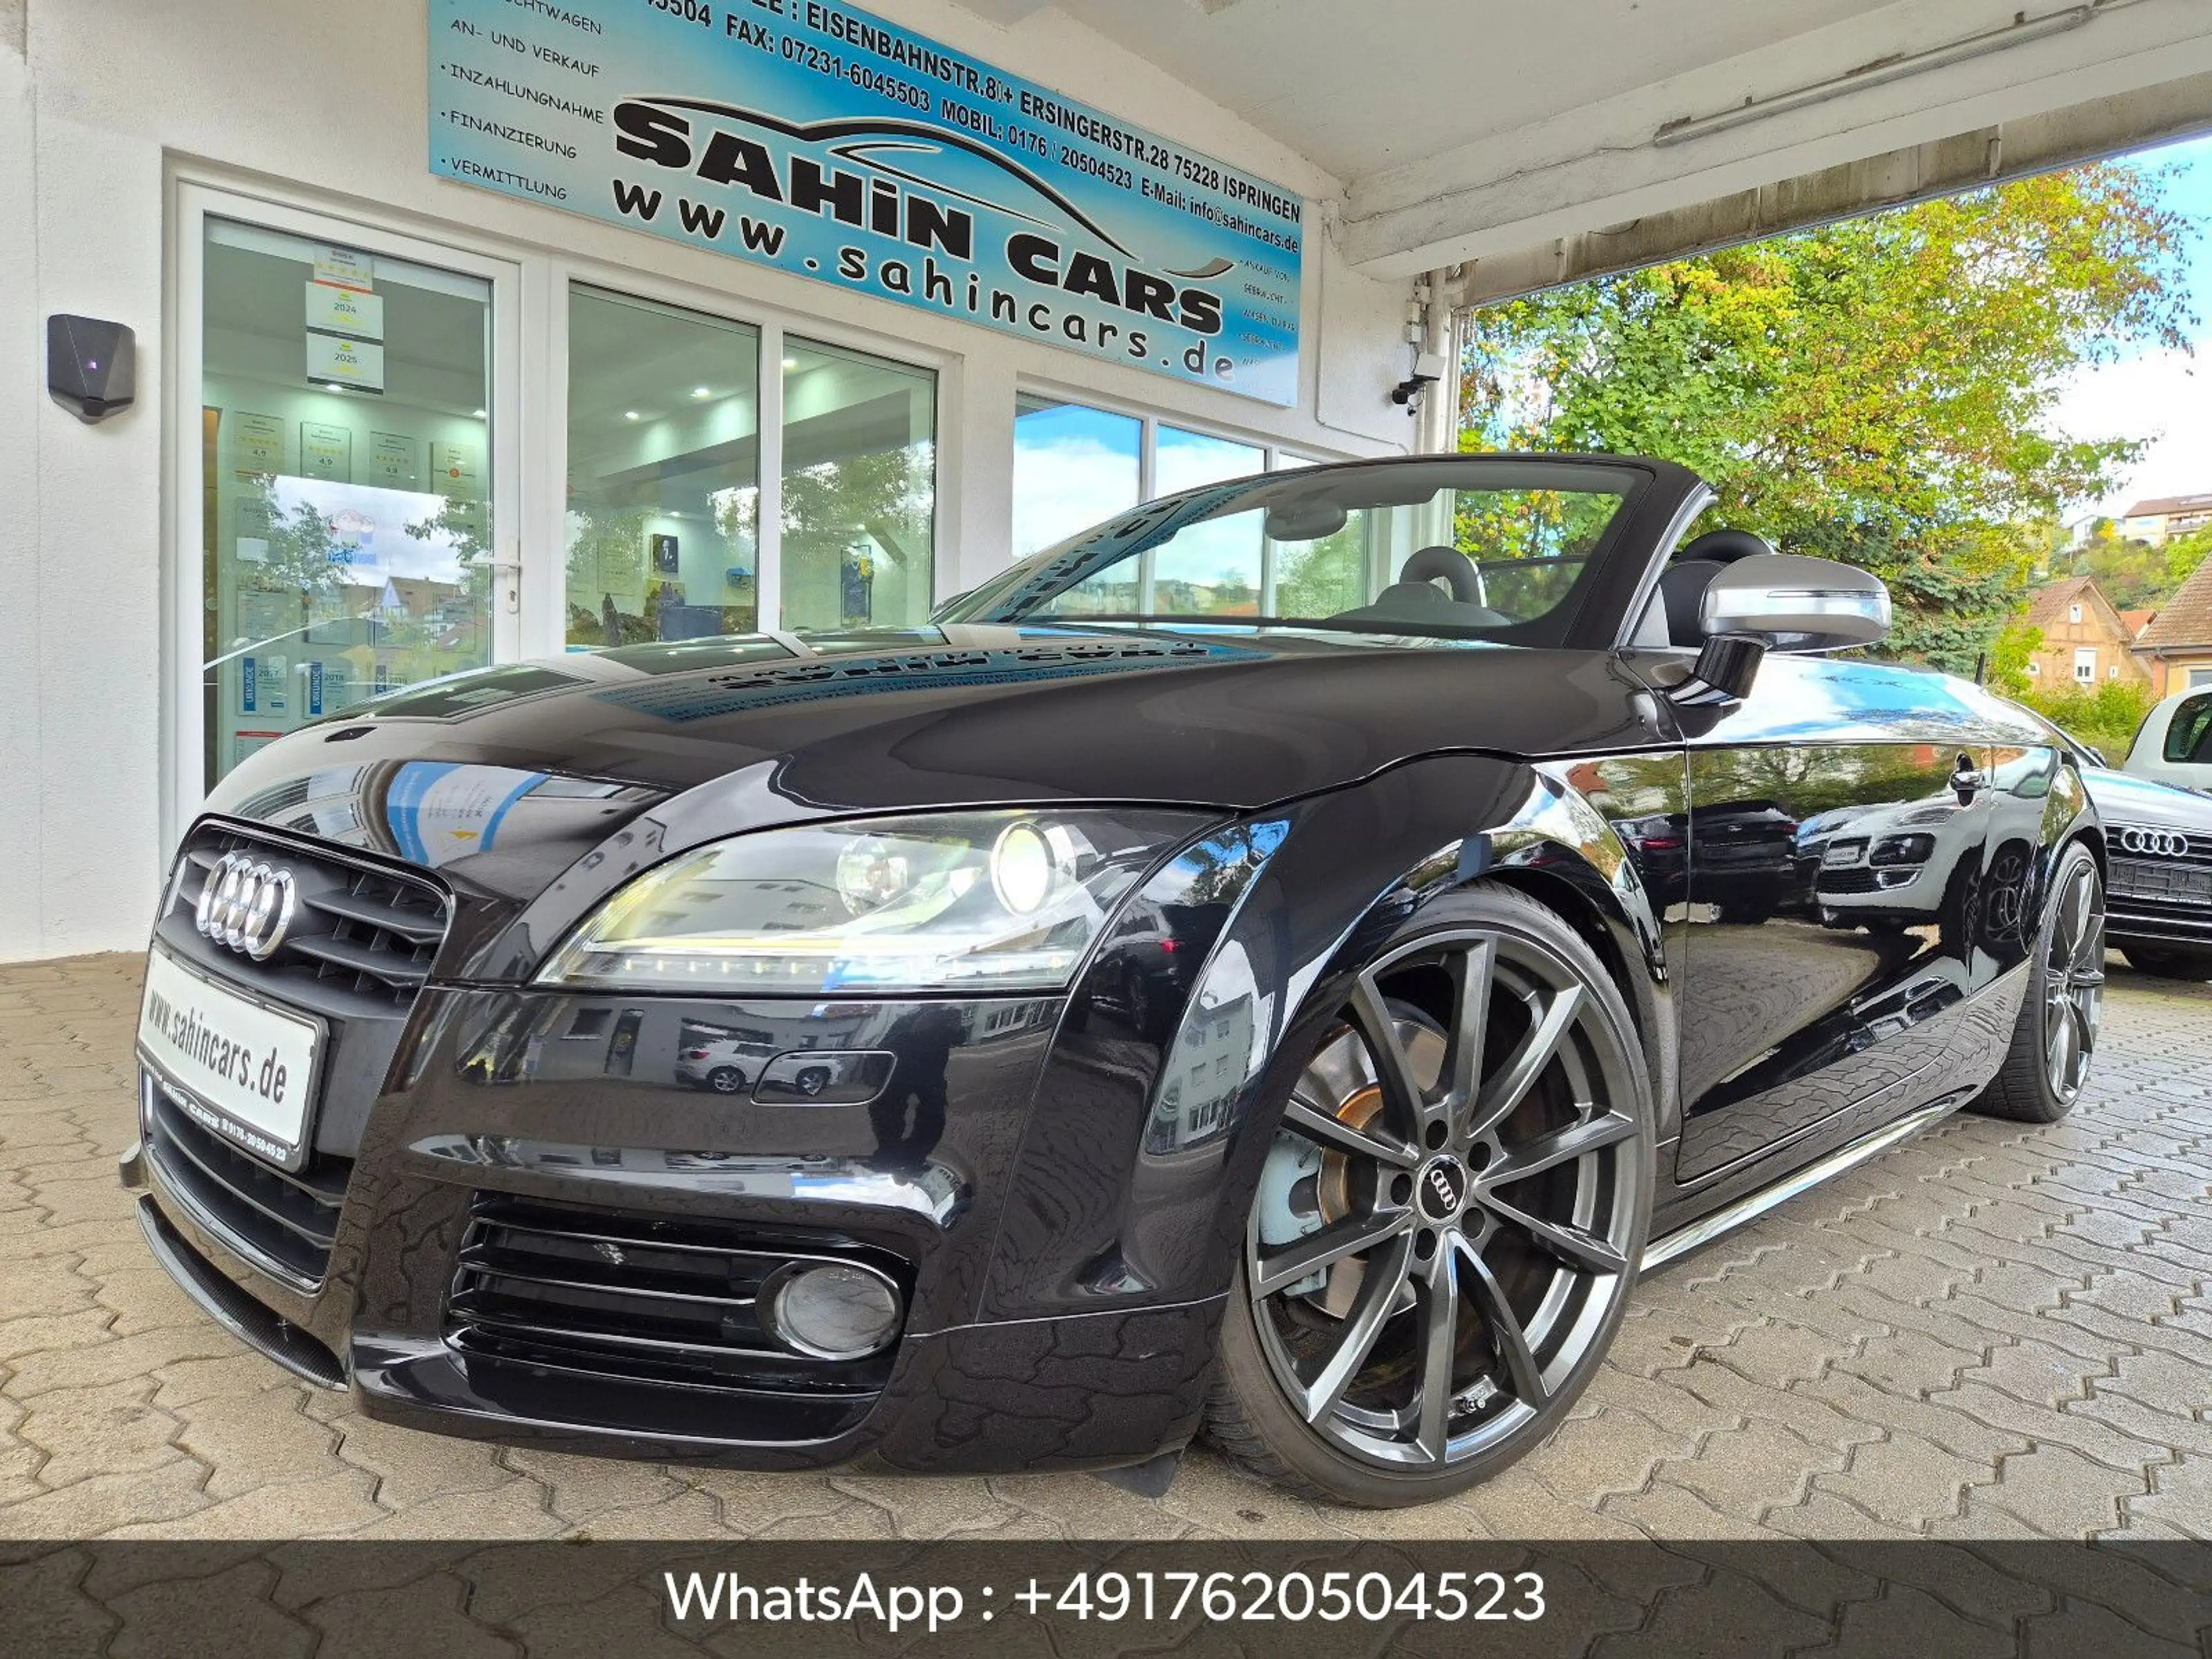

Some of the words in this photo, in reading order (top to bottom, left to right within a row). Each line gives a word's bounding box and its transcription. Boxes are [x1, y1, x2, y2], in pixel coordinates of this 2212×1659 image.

[450, 18, 483, 36] AN-
[491, 31, 527, 53] UND
[532, 44, 600, 77] VERKAUF
[450, 63, 604, 125] INZAHLUNGNAHME
[726, 13, 774, 52] FAX:
[781, 36, 930, 112] 07231-6045503
[941, 99, 1003, 139] MOBIL:
[1009, 125, 1047, 157] 0176
[1060, 146, 1132, 190] 20504523
[1141, 177, 1186, 211] E-Mail:
[1190, 196, 1298, 253] info@sahincars.de
[450, 110, 577, 160] FINANZIERUNG
[1020, 90, 1168, 170] ERSINGERSTR.28
[1174, 154, 1219, 190] 75228
[1223, 175, 1300, 223] ISPRINGEN
[451, 157, 567, 200] VERMITTLUNG
[1007, 233, 1221, 334] CARS
[149, 989, 287, 1103] www.sahincars.de
